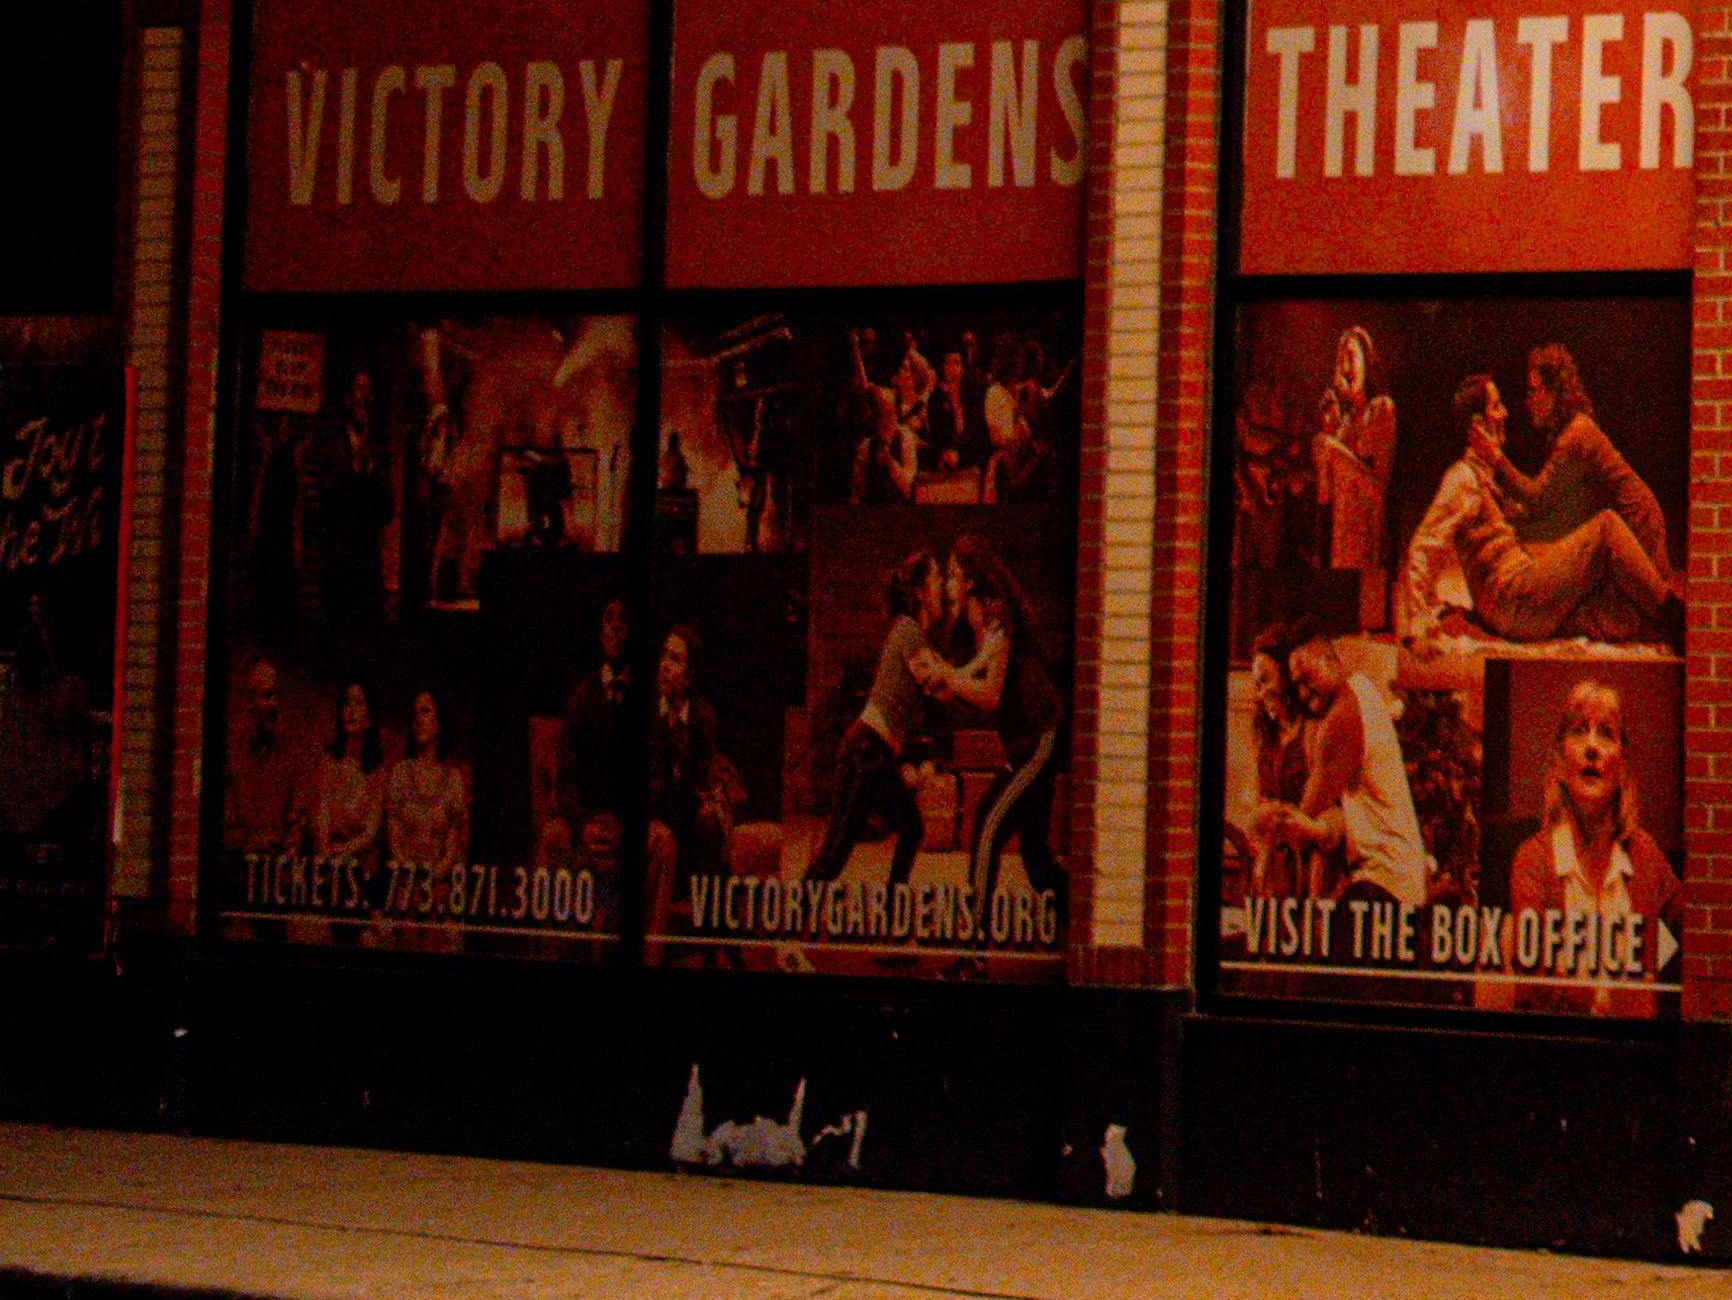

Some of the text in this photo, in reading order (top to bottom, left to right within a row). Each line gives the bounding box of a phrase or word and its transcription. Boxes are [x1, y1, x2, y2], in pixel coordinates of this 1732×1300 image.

[283, 58, 625, 206] VICTORY
[691, 34, 1088, 201] GARDENS
[1265, 10, 1694, 179] THEATER
[242, 852, 596, 926] TICKETS: 773.871.3000
[689, 873, 1058, 945] VICTORYGARDENS.ORG
[1244, 896, 1645, 974] VISIT THE BOX OFFICE
